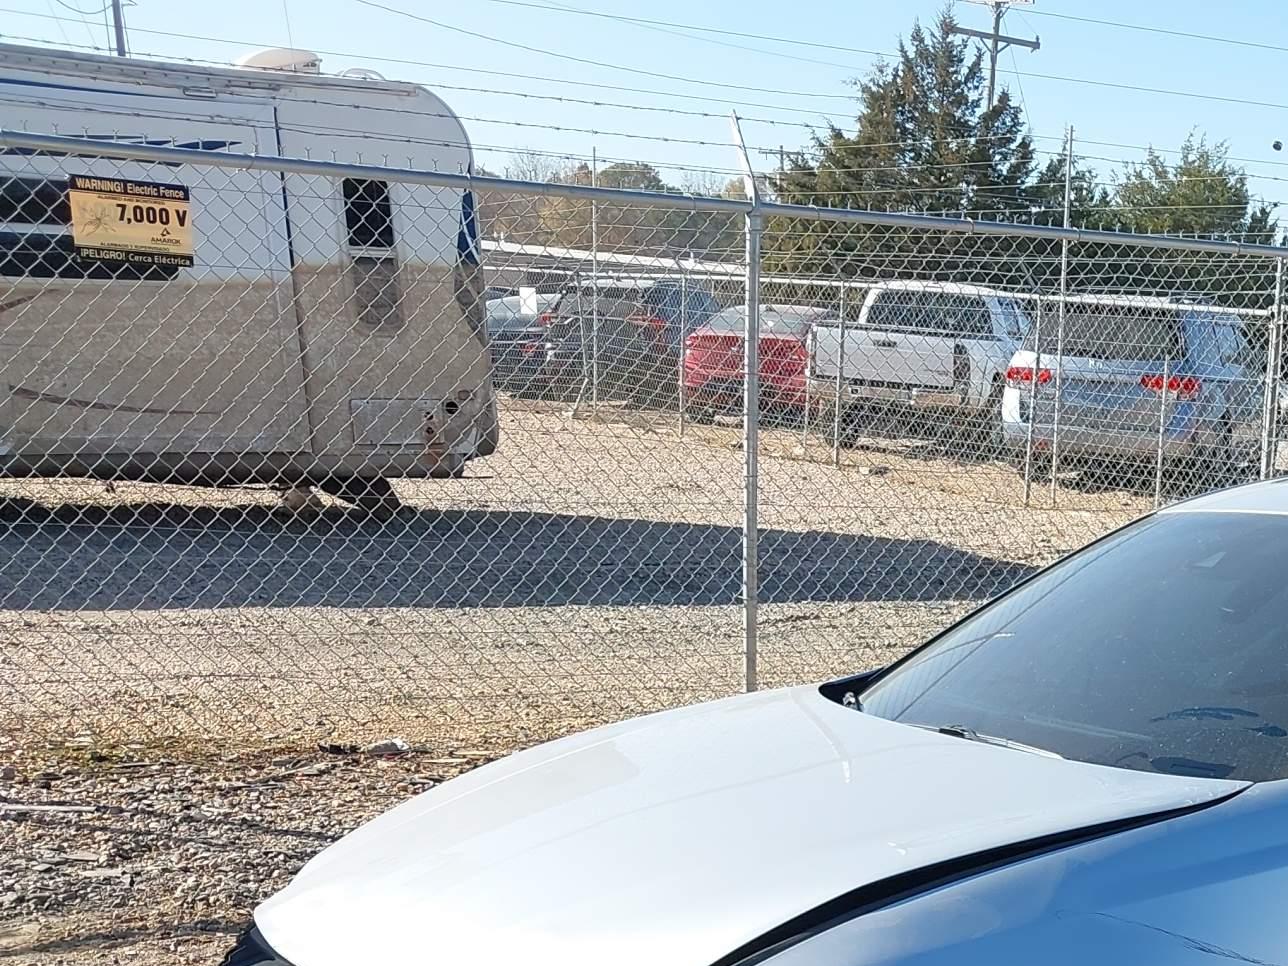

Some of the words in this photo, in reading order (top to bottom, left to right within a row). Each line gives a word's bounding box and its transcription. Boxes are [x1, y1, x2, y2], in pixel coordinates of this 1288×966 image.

[75, 178, 124, 192] WARNING!
[127, 183, 158, 196] Electric
[160, 187, 184, 198] Fence
[116, 203, 170, 225] 7,000
[174, 209, 188, 227] V
[128, 253, 152, 263] Cerca
[154, 255, 191, 266] Eléctrica
